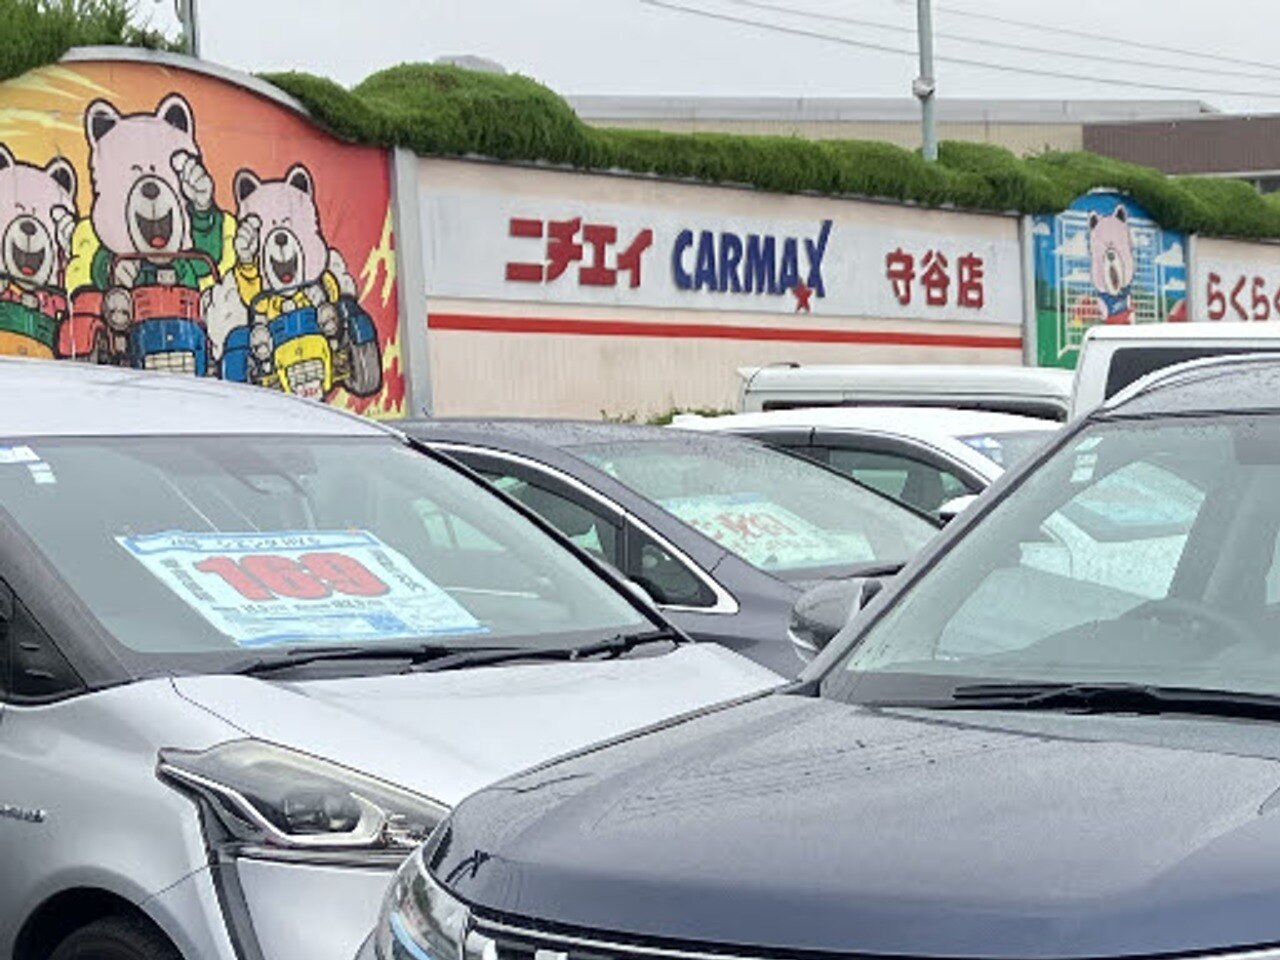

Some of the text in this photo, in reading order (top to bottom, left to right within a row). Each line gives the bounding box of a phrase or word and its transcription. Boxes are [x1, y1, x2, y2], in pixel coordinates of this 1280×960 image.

[673, 220, 833, 300] CARMAX
[887, 249, 985, 308] 守谷店
[194, 551, 391, 602] 169
